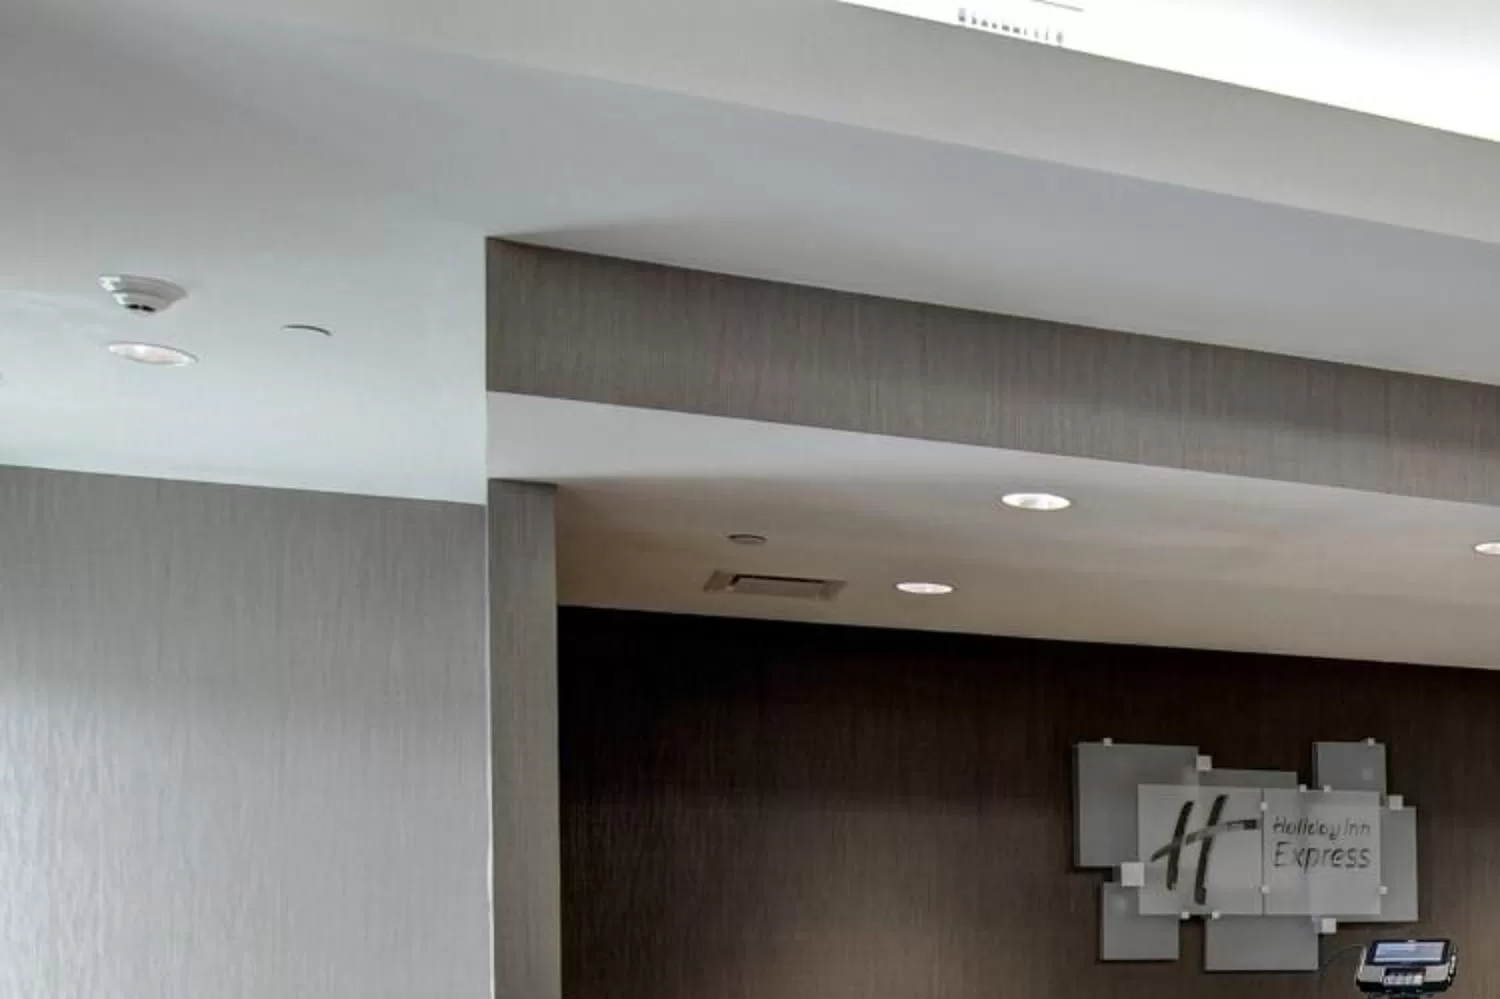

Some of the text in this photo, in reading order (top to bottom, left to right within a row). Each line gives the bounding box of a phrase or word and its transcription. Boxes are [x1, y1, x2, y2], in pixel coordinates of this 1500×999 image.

[1272, 815, 1371, 841] Holiday Inn
[1273, 840, 1371, 875] Express
